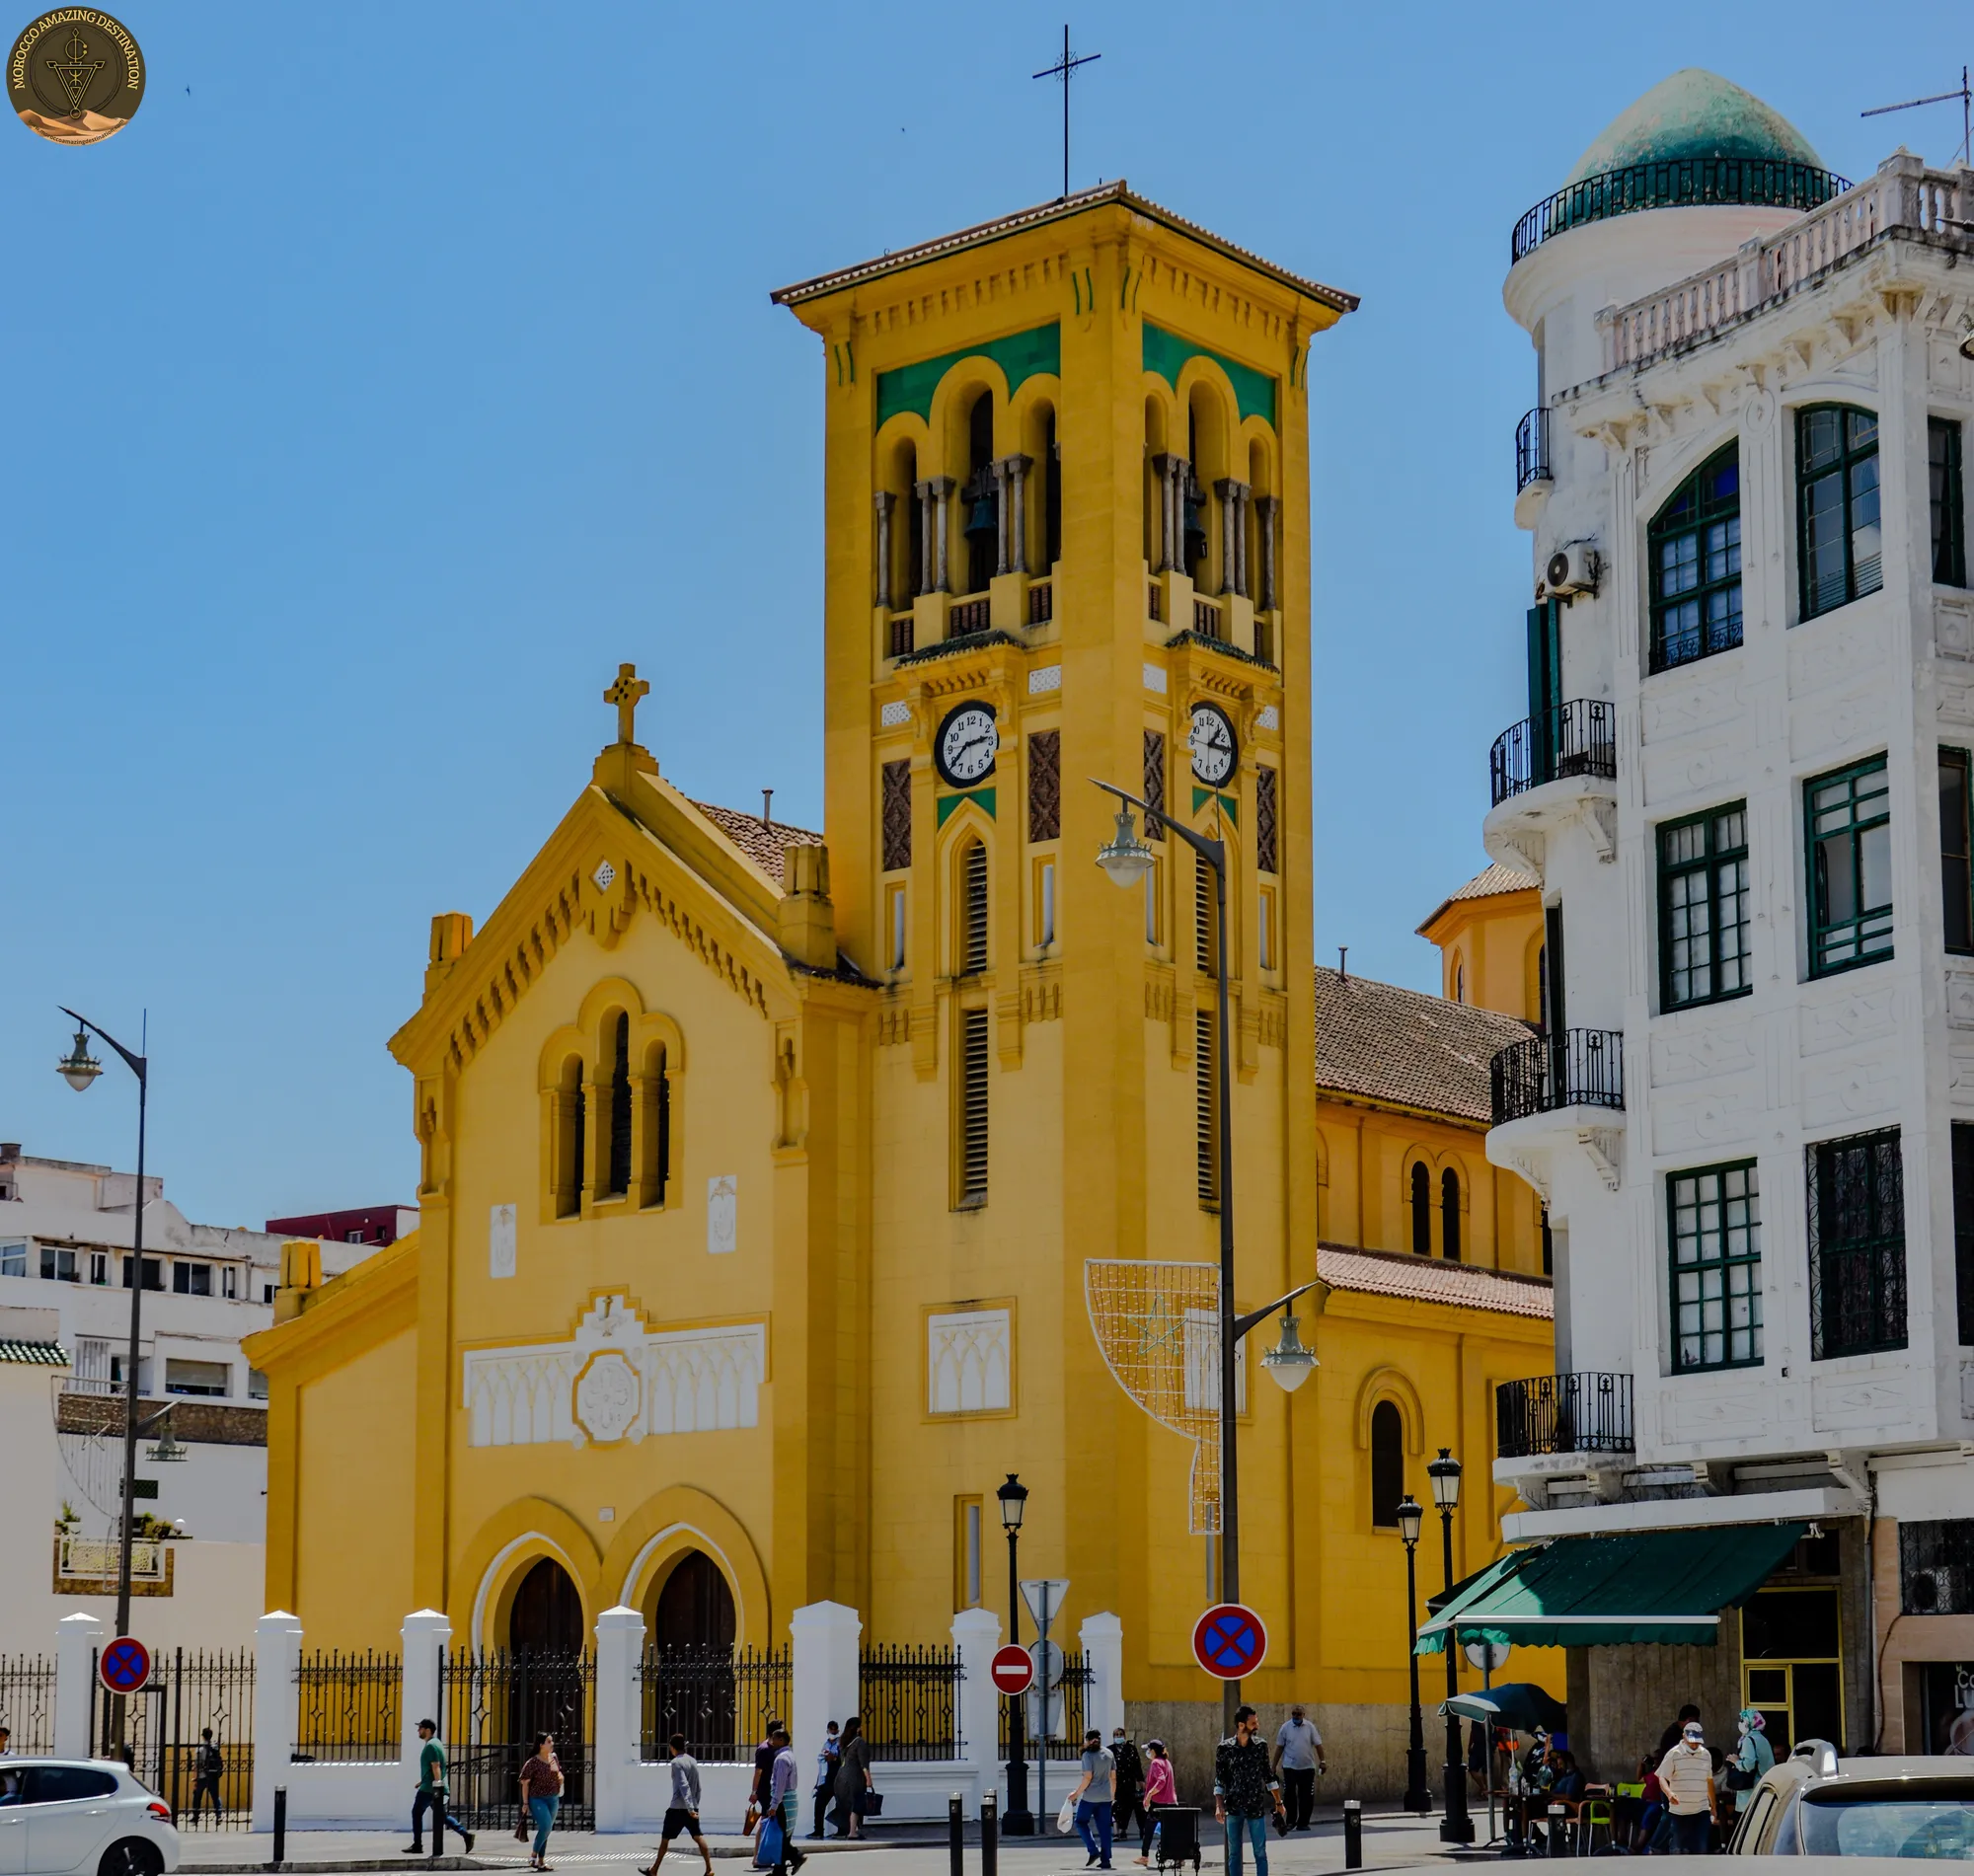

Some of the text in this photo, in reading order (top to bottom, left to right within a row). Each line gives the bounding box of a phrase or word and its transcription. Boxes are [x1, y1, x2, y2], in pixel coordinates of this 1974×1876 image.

[966, 715, 976, 726] 12
[1198, 717, 1204, 726] 11
[1206, 716, 1215, 726] 12
[957, 721, 964, 731] 11
[985, 724, 991, 734] 2
[949, 732, 959, 743] 10
[988, 736, 994, 746] 3
[948, 745, 953, 755] 9
[984, 749, 990, 759] 4
[978, 759, 984, 769] 5
[967, 765, 974, 774] 6
